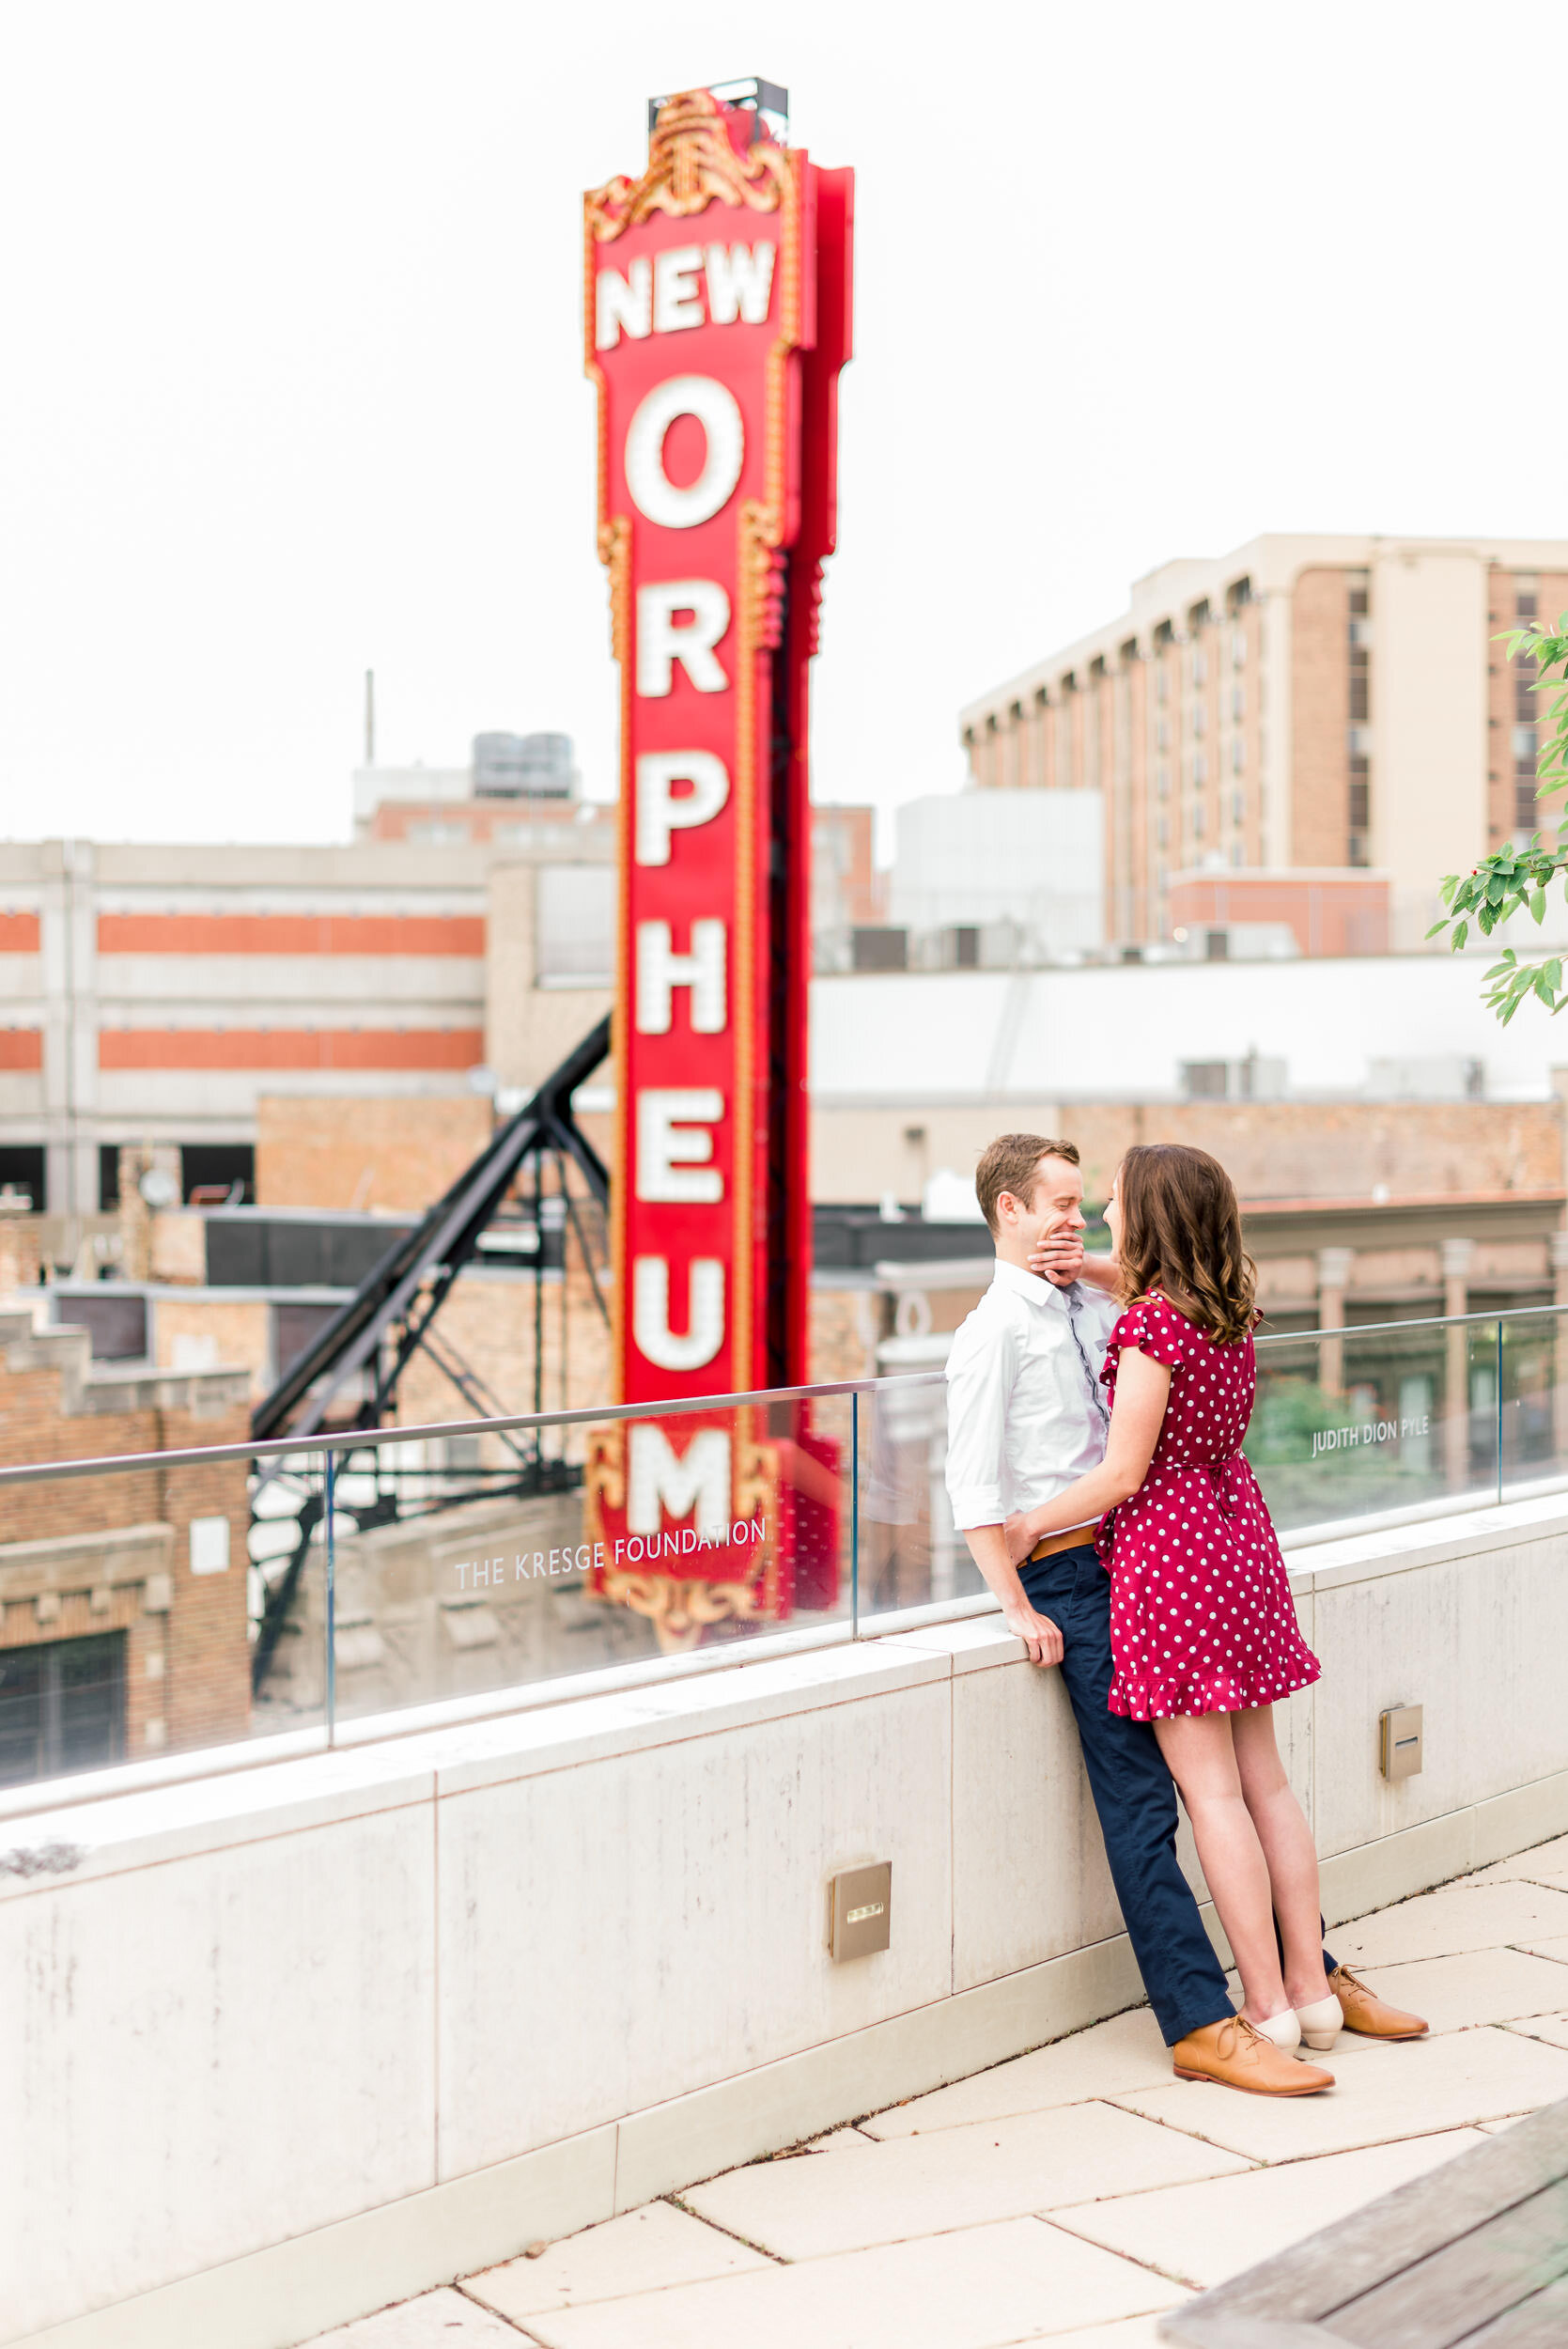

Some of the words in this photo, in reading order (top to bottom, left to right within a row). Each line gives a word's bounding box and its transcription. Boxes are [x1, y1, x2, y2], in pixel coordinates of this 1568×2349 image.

[596, 241, 777, 350] NEW
[625, 374, 744, 1540] ORPHEUM
[1312, 1426, 1358, 1458] JUDITH
[1363, 1420, 1397, 1444] DION
[1401, 1415, 1429, 1438] PYLE
[456, 1558, 504, 1589] THE
[516, 1542, 604, 1580] KRESGE
[614, 1517, 767, 1564] FOUNDATION
